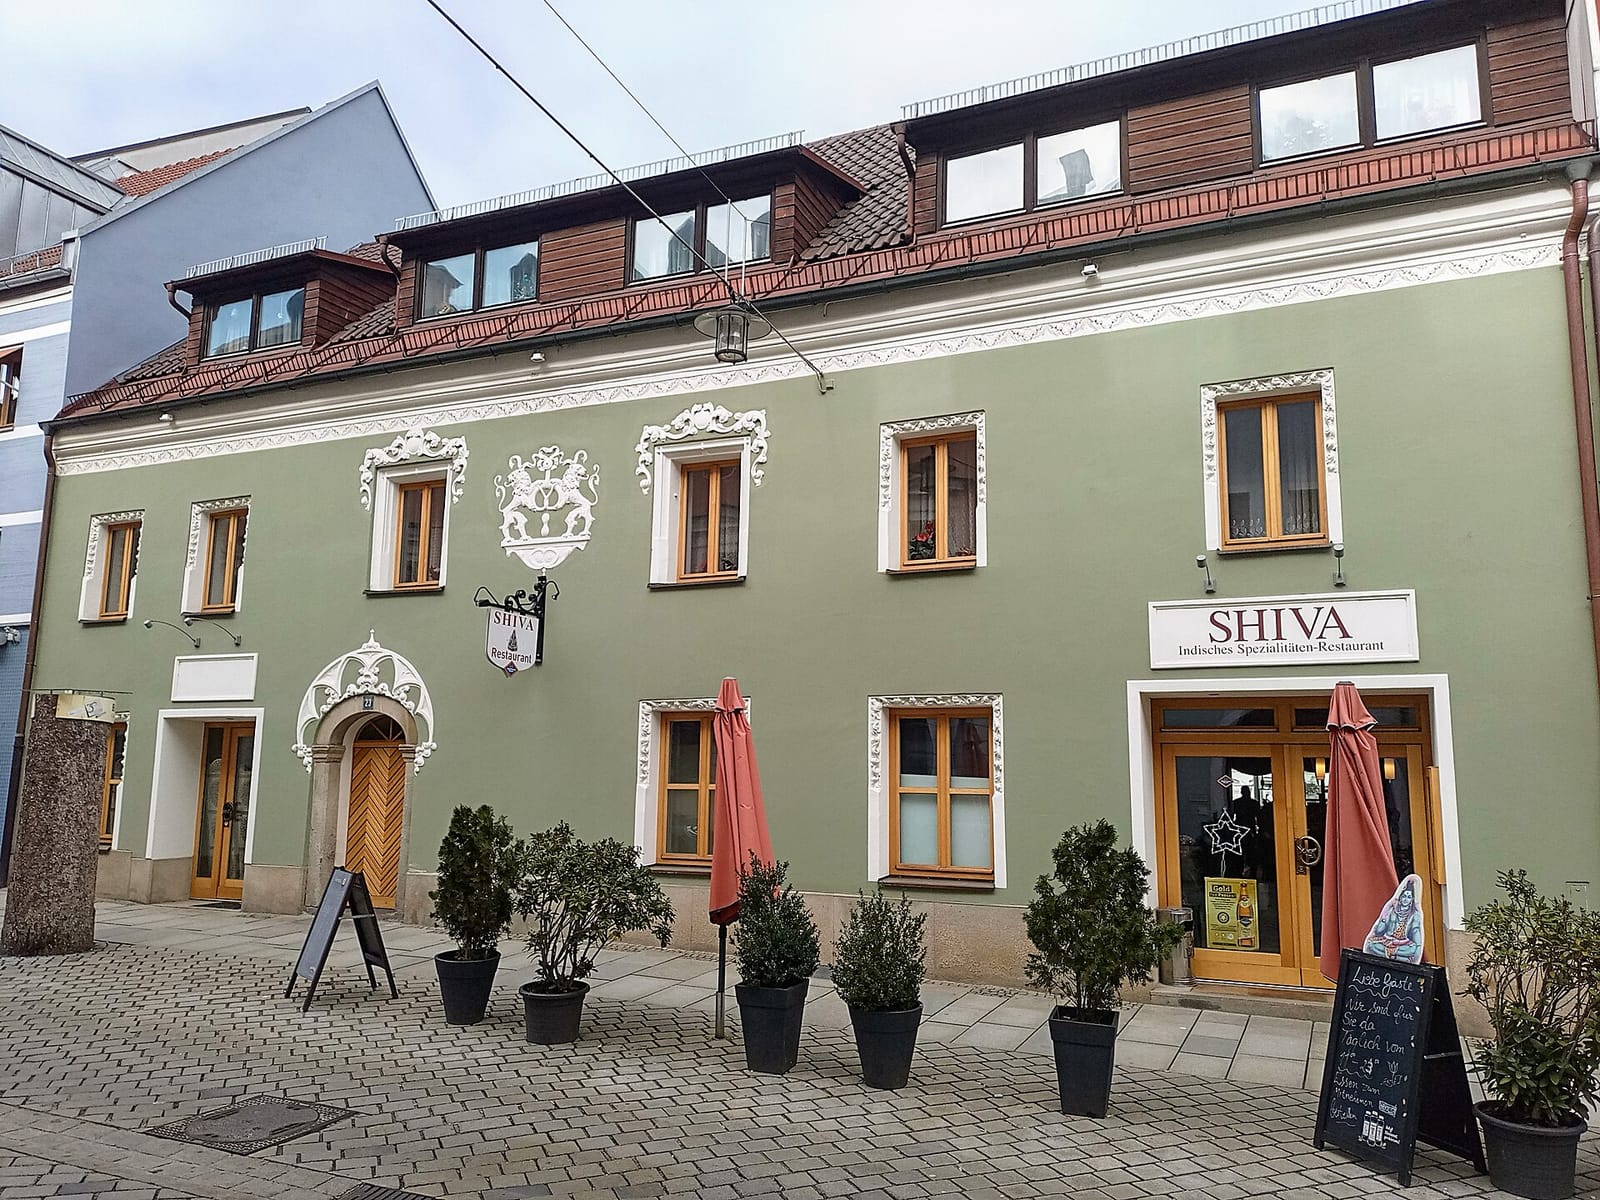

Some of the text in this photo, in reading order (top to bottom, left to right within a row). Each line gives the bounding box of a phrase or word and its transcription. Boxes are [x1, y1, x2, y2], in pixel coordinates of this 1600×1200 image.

[493, 611, 534, 631] SHIVA
[1208, 605, 1353, 643] SHIVA
[491, 647, 532, 664] Restaurant
[1179, 640, 1384, 657] Indisches Spezialitäten-Restaurant
[1212, 884, 1231, 892] Gold
[1352, 965, 1381, 987] Liebe
[1342, 1011, 1376, 1031] Sie da
